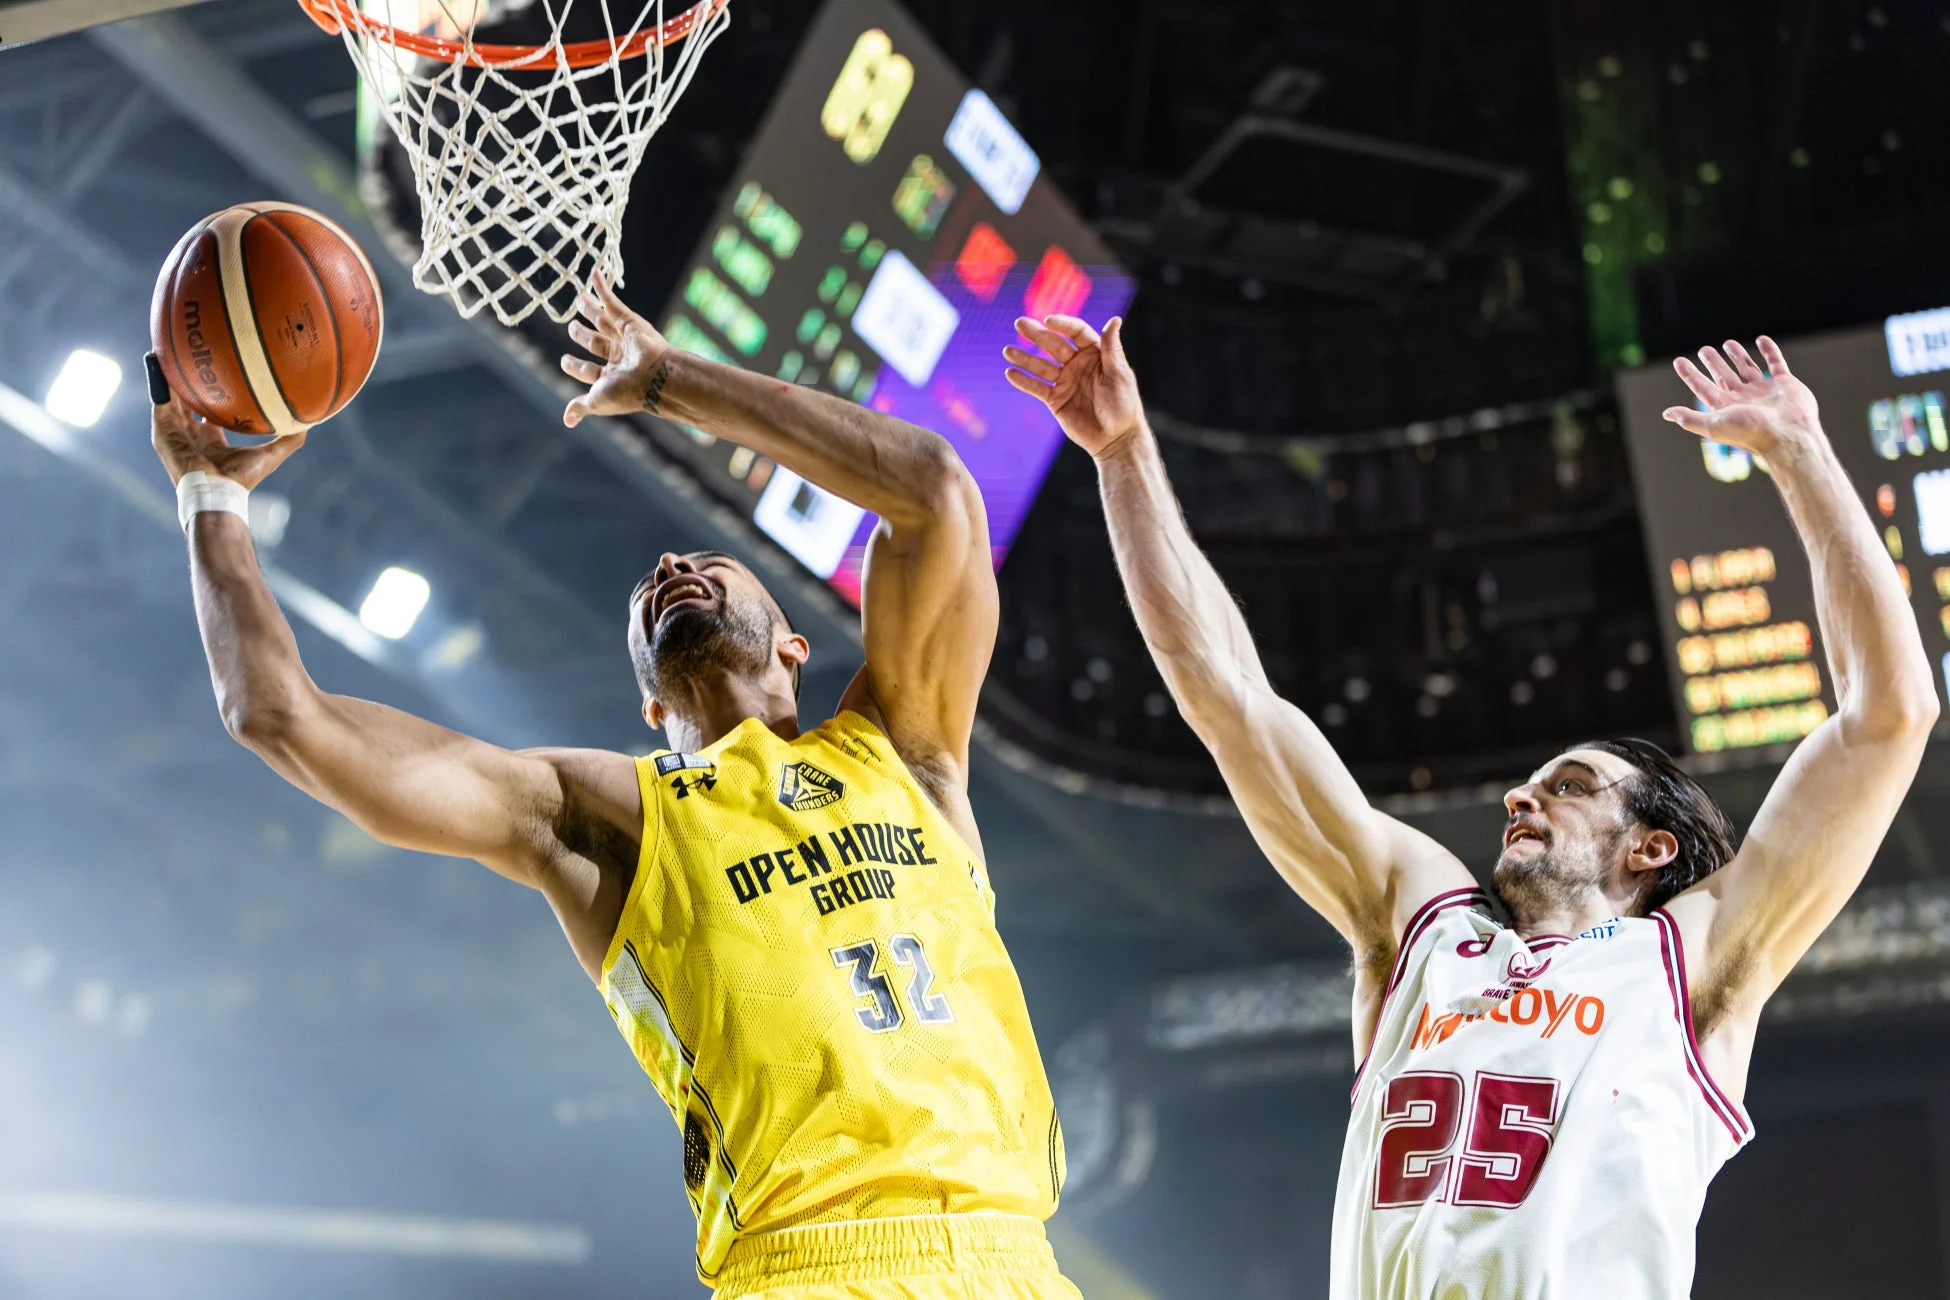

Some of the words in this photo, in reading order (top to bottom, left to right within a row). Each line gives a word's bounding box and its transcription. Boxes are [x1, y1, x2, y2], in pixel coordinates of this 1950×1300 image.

[184, 300, 226, 402] molten
[790, 790, 840, 812] THUNDERS
[797, 764, 832, 787] CRANE
[725, 835, 832, 905] OPEN
[828, 822, 937, 866] HOUSE
[809, 868, 896, 916] GROUP
[829, 932, 956, 1034] 32
[1372, 1069, 1561, 1210] 25
